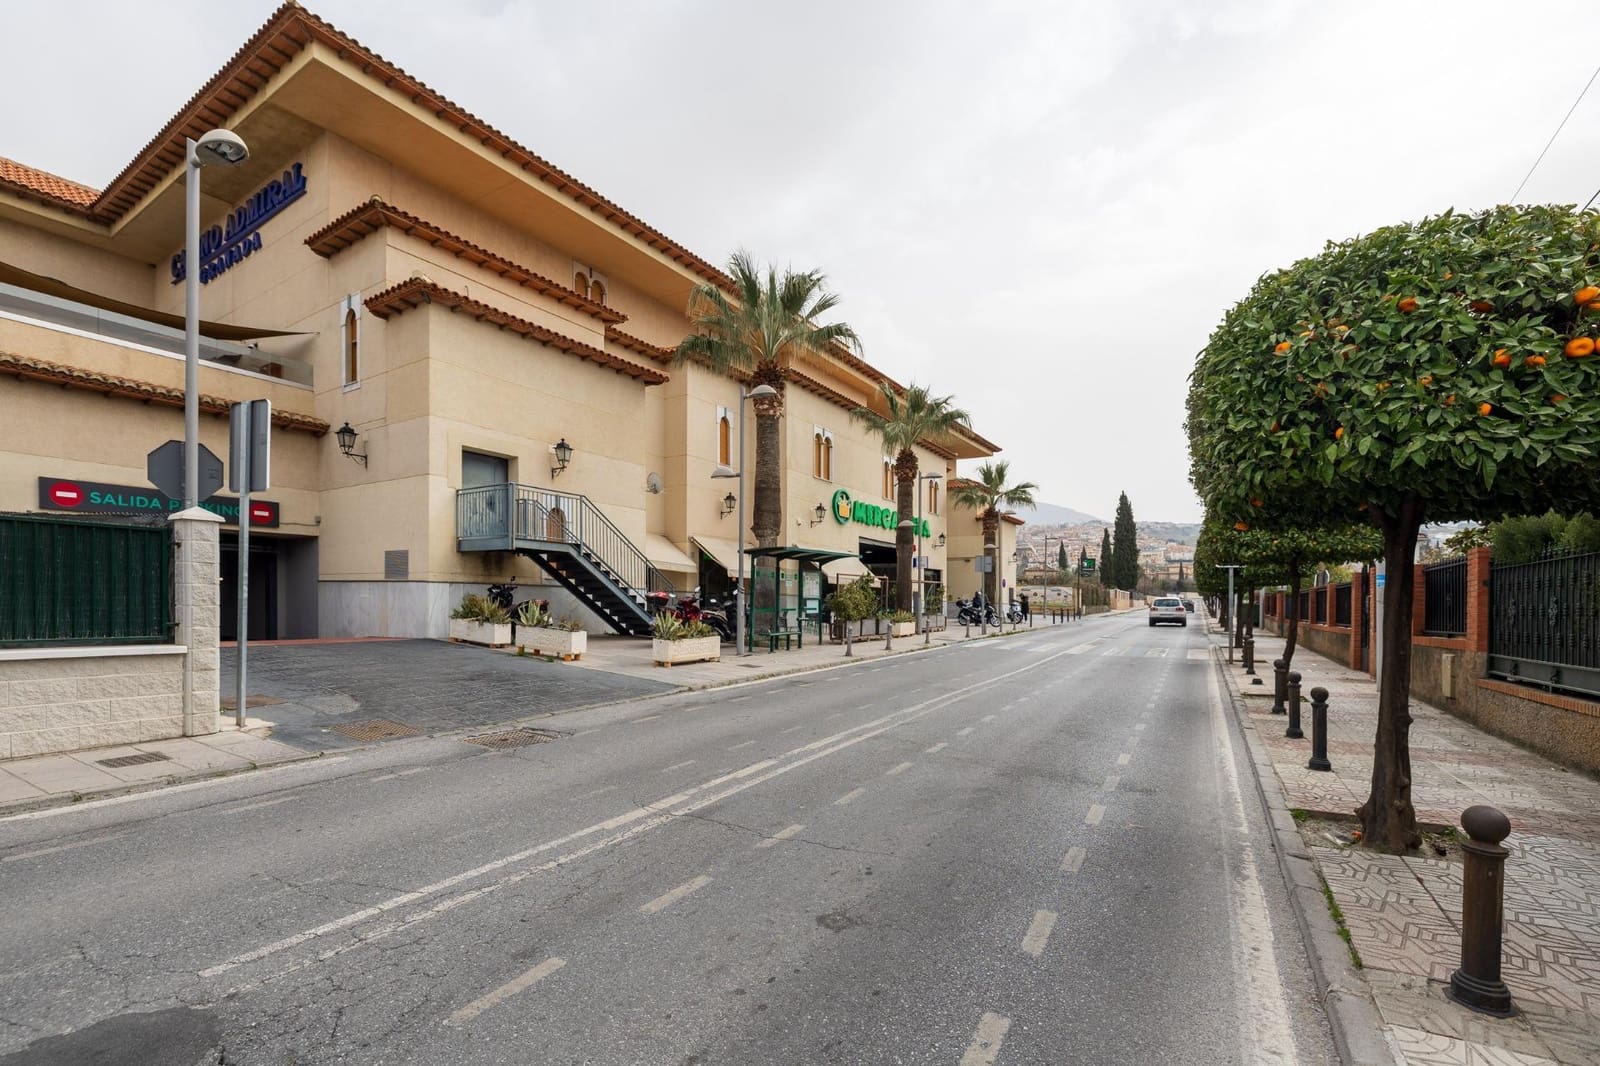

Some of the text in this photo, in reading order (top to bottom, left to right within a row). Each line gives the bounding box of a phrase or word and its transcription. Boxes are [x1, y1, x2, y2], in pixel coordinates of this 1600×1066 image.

[224, 162, 307, 242] ADMIRAL
[89, 491, 241, 517] SALIDA PKIN
[852, 501, 930, 537] MERCANA
